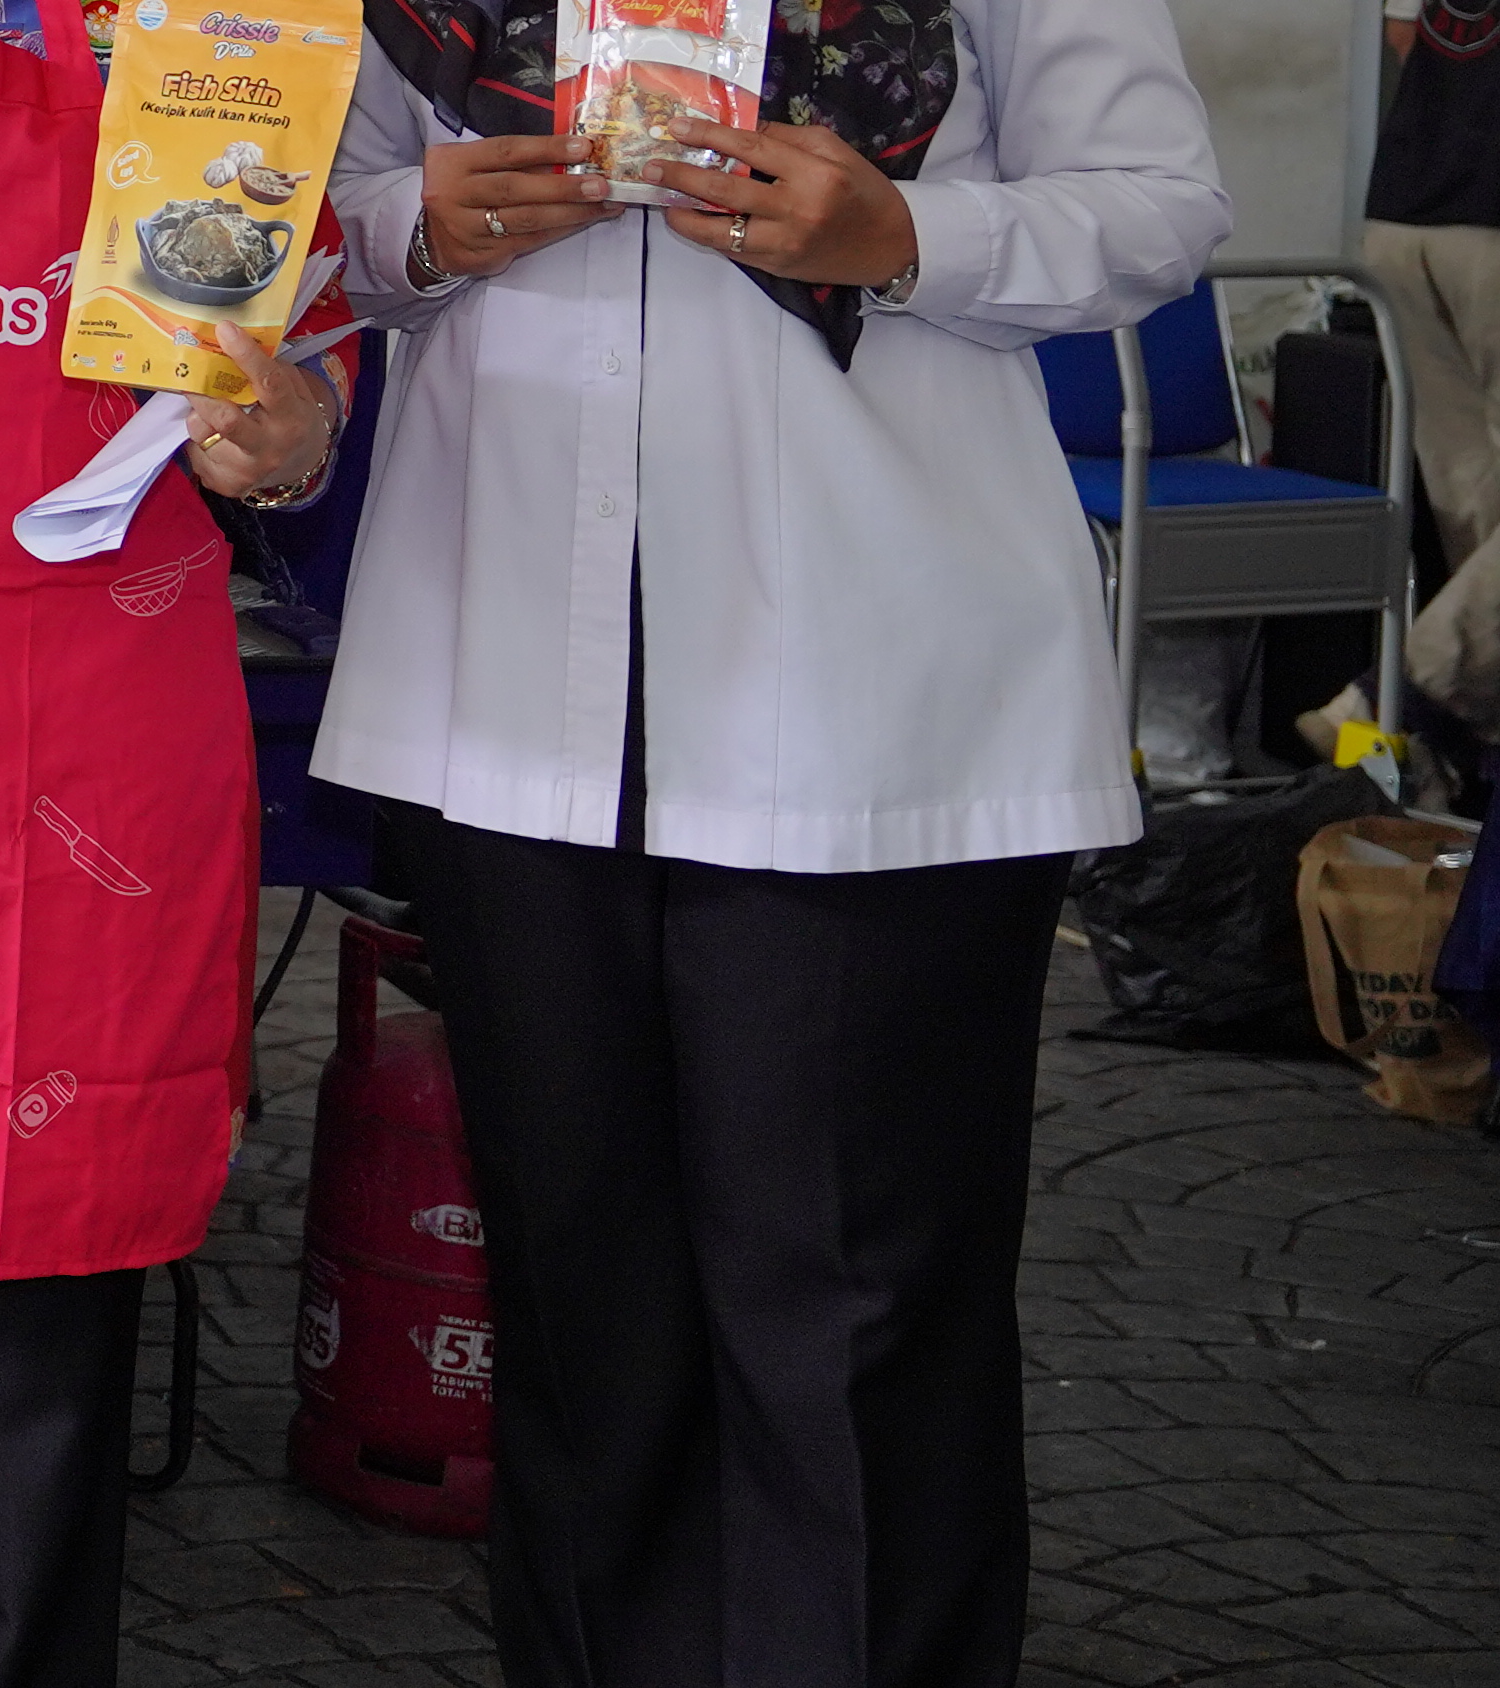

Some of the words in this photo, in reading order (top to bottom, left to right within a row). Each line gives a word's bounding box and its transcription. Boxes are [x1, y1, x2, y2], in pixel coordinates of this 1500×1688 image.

[162, 70, 219, 102] Fish
[218, 76, 283, 109] Skin
[140, 100, 188, 118] (Keripik
[188, 105, 216, 120] Kulit
[217, 108, 246, 123] Ikan
[247, 112, 291, 130] Krispi)
